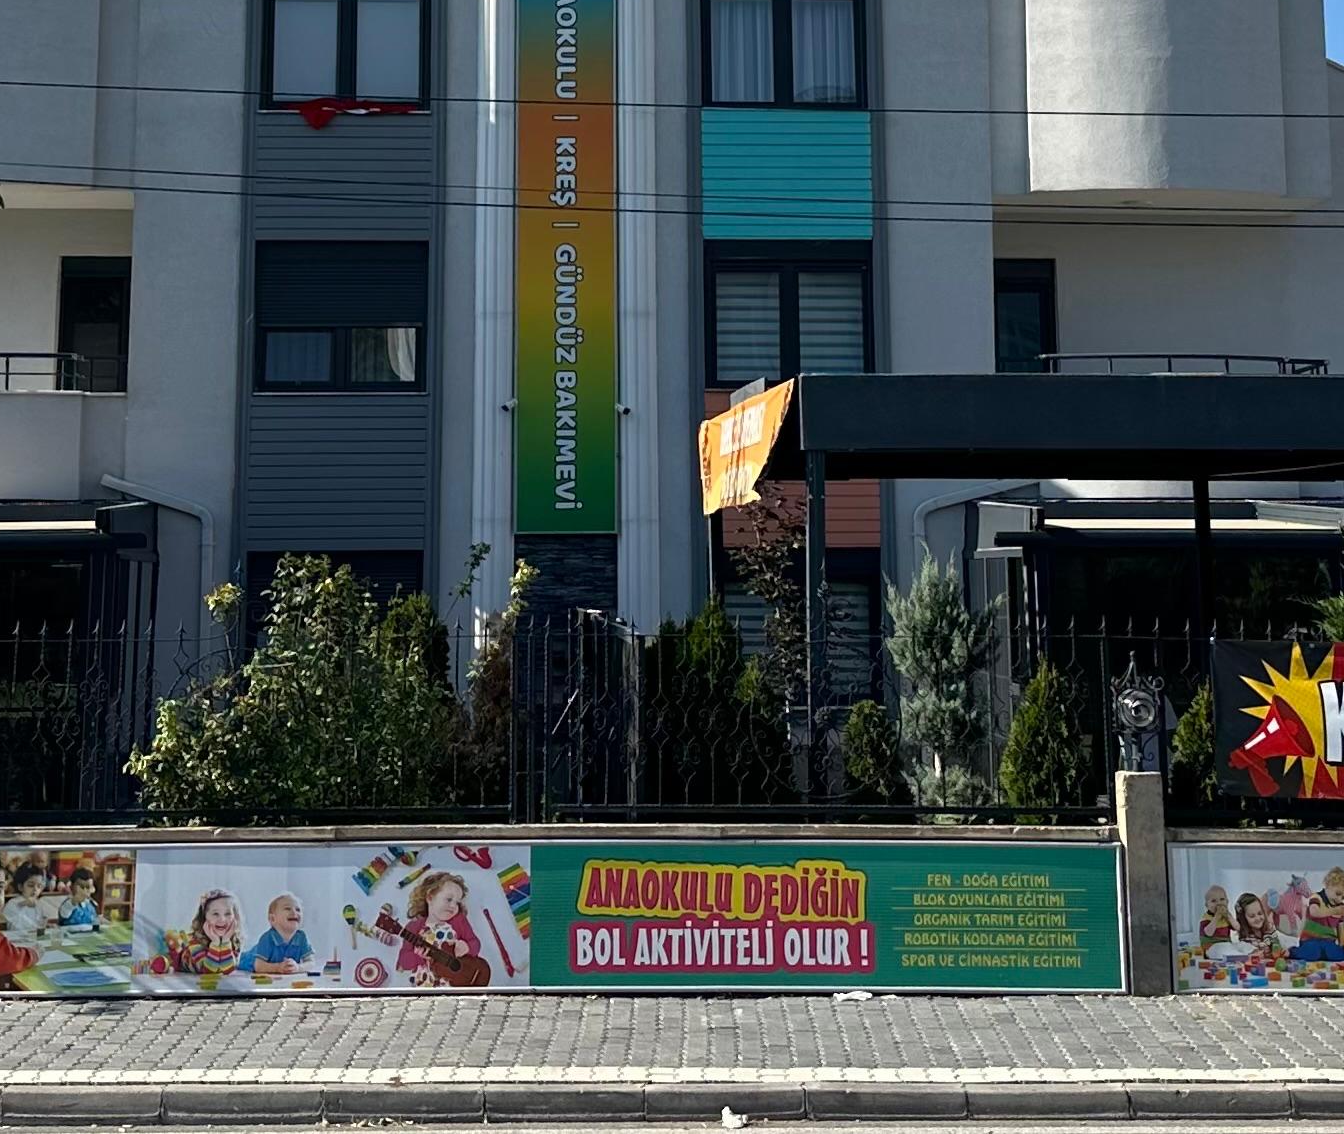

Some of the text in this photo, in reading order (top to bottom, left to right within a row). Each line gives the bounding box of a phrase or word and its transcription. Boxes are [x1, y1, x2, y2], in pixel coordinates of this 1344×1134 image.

[550, 137, 576, 207] KREŞ
[555, 243, 583, 364] GÜNDÜZ
[555, 370, 582, 509] BAKIMEVİ
[585, 867, 860, 918] ANAOKULU DEDİĞİN
[927, 874, 951, 887] FEN
[963, 872, 998, 887] DOĞA
[1001, 872, 1049, 887] EĞİTİMİ
[913, 892, 1065, 907] BLOK OYUNLARI EĞİTİMİ
[914, 912, 1066, 927] ORGANİK TARIM EĞİTİMİ
[576, 920, 868, 966] BOL AKTİVİTELİ OLUR !
[904, 932, 1077, 947] ROBOTİK KODLAMA EĞİTİMİ
[901, 954, 936, 967] SPOR
